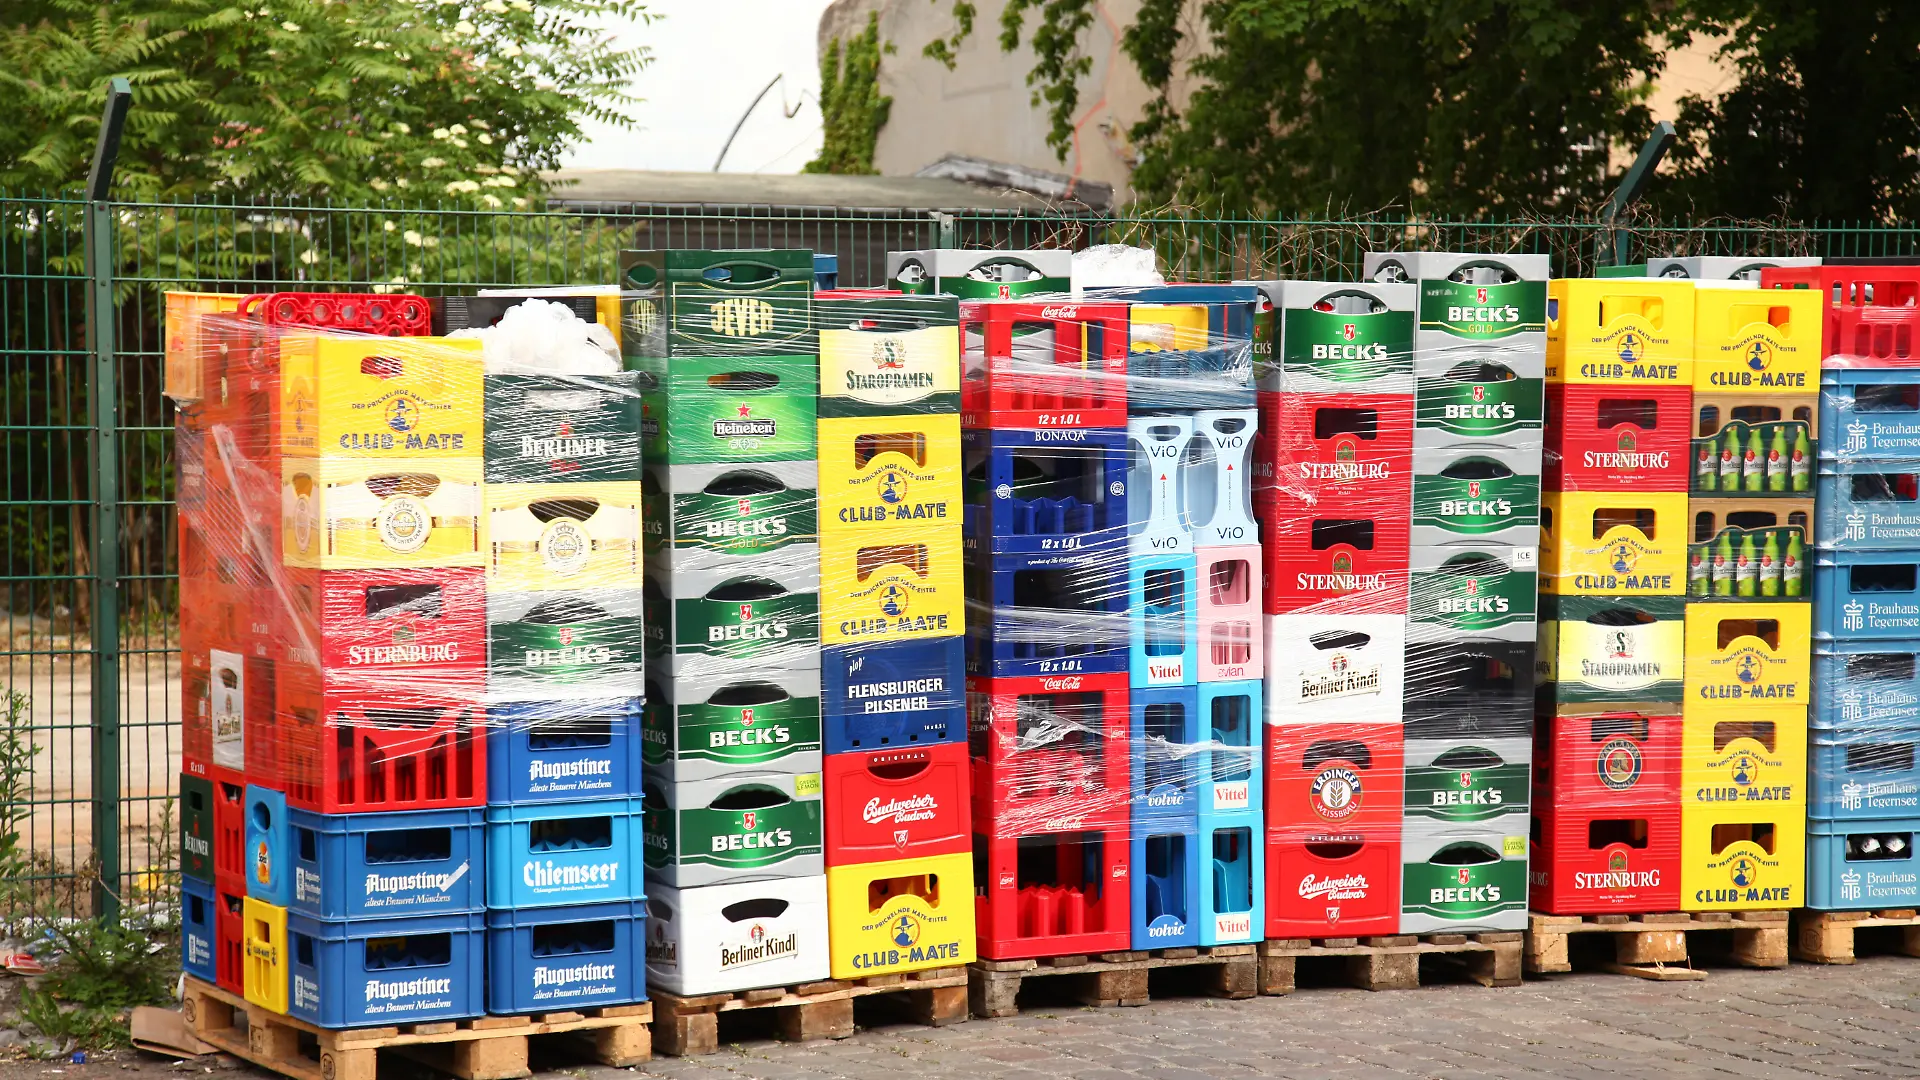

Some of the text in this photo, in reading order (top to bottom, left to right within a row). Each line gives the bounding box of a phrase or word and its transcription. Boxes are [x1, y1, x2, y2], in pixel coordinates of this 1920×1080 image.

[710, 298, 774, 336] JEVER
[1042, 305, 1076, 319] Coca-Cola
[1448, 304, 1518, 322] BECK'S
[1468, 324, 1493, 334] GOLD
[1603, 326, 1636, 342] PRICKELNDE
[1312, 342, 1387, 360] BECK'S
[1581, 364, 1677, 379] CLUB-MATE
[1710, 372, 1806, 387] CLUB-MATE
[846, 370, 933, 390] STAROPRAMEN
[1445, 402, 1515, 419] BECK'S
[1038, 414, 1049, 425] 12
[1059, 414, 1074, 424] 1.0
[1075, 414, 1081, 424] L
[716, 423, 774, 435] Heineken
[1035, 431, 1085, 442] BONAQA
[340, 433, 464, 450] CLUB-MATE
[521, 436, 608, 457] BERLINER
[1216, 437, 1243, 448] ViO
[1150, 445, 1177, 458] ViO
[1584, 450, 1669, 468] STERNBURG
[1300, 462, 1390, 479] STERNBURG
[839, 503, 946, 522] CLUB-MATE
[1441, 498, 1511, 516] BECK'S
[706, 518, 787, 538] BECK'S
[1217, 527, 1243, 539] ViO
[1041, 539, 1052, 548] 12
[1062, 539, 1075, 548] 1.0
[1075, 539, 1082, 548] L
[1150, 537, 1178, 549] ViO
[1297, 572, 1386, 590] STERNBURG
[1575, 575, 1671, 589] CLUB-MATE
[1438, 595, 1508, 613] BECK'S
[1869, 603, 1919, 614] Brauhaus
[709, 620, 788, 641] BECK'S
[841, 614, 948, 635] CLUB-MATE
[1868, 616, 1920, 629] Tegernsee
[349, 642, 459, 665] STERNBURG
[526, 647, 612, 666] BECK'S
[1040, 661, 1050, 672] 12
[1062, 661, 1074, 670] 1.0
[1076, 660, 1082, 670] L
[1150, 665, 1181, 679] Vittel
[1218, 666, 1244, 677] evian
[1581, 659, 1660, 677] STAROPRAMEN
[848, 678, 943, 698] FLENSBURGER
[1044, 677, 1081, 690] Coca-Cola
[1302, 669, 1378, 698] Berliner Kindl
[1700, 684, 1795, 699] CLUB-MATE
[865, 697, 928, 714] PILSENER
[1868, 692, 1917, 704] Brauhaus
[709, 726, 790, 748] BECK'S
[874, 753, 925, 763] ORIGINAL
[529, 759, 611, 781] Augustiner
[549, 782, 577, 792] Brauerei
[797, 782, 819, 791] LEMON
[1313, 769, 1360, 790] ERDINGER
[1216, 788, 1247, 801] Vittel
[1433, 787, 1502, 806] BECK'S
[1696, 787, 1791, 802] CLUB-MATE
[1867, 783, 1917, 794] Brauhaus
[1148, 792, 1183, 806] volvic
[1866, 795, 1917, 808] Tegernsee
[863, 794, 938, 824] Budweiser
[895, 809, 936, 824] Budvar
[184, 831, 208, 856] BERLINER
[712, 828, 792, 852] BECK'S
[524, 860, 618, 887] Chiemseer
[1575, 870, 1660, 889] STERNBURG
[1867, 872, 1916, 884] Brauhaus
[365, 872, 450, 895] Augustiner
[1299, 874, 1368, 900] Budweiser
[1866, 885, 1916, 897] Tegernsee
[386, 896, 414, 906] Brauerei
[1328, 888, 1366, 900] Budvar
[1430, 884, 1500, 904] BECK'S
[1696, 887, 1790, 902] CLUB-MATE
[875, 908, 910, 929] PRICKELNDE
[1148, 923, 1185, 937] volvic
[1218, 920, 1250, 934] Vittel
[722, 934, 796, 967] Berliner Kindl
[853, 943, 959, 968] CLUB-MATE
[533, 963, 615, 988] Augustiner
[365, 977, 450, 1000] Augustiner
[553, 988, 581, 998] Brauerei
[386, 1002, 414, 1012] Brauerei
